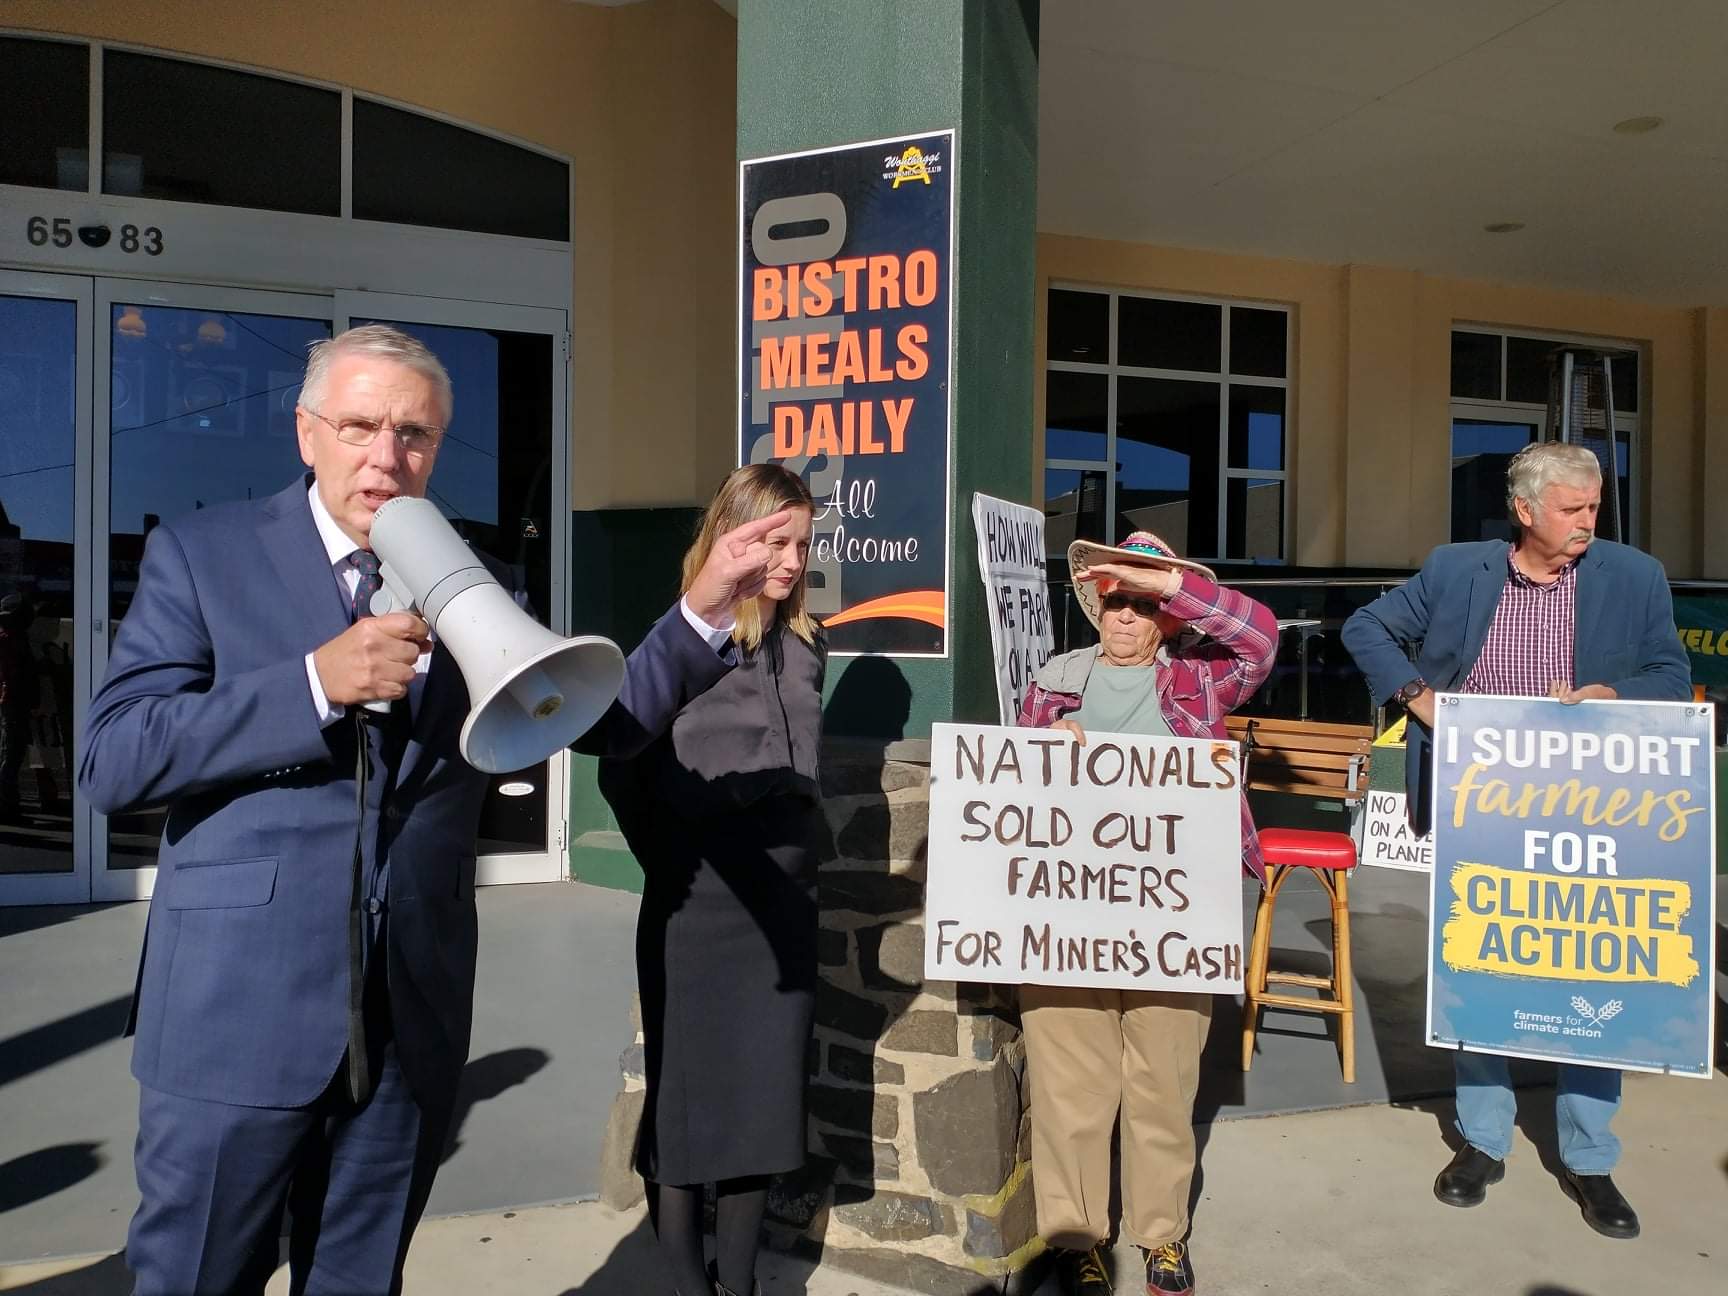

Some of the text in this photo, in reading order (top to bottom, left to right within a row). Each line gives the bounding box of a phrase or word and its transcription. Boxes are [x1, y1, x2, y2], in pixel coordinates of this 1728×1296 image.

[27, 216, 164, 256] 65 83
[753, 250, 938, 321] BISTRO
[760, 324, 929, 390] MEALS
[773, 398, 914, 459] DAILY
[812, 479, 876, 521] All
[806, 524, 918, 563] elcome
[987, 511, 1046, 571] HOW WILL
[994, 585, 1016, 630] WE
[955, 734, 1237, 790] NATIONALS
[1446, 726, 1700, 777] I SUPPORT
[961, 800, 1184, 854] SOLD OUT
[1371, 795, 1397, 814] NO
[1449, 762, 1706, 842] farmers
[1370, 820, 1390, 837] ON
[1394, 824, 1407, 841] A
[1376, 841, 1432, 865] PLANE
[1524, 830, 1618, 876] FOR
[1008, 857, 1190, 912] FARMERS
[1466, 874, 1676, 931] CLIMATE
[936, 920, 1001, 968] FOR
[1157, 931, 1241, 981] CASH
[1478, 922, 1659, 977] ACTION
[1513, 1009, 1583, 1026] farmers for
[1513, 1020, 1602, 1038] climate action
